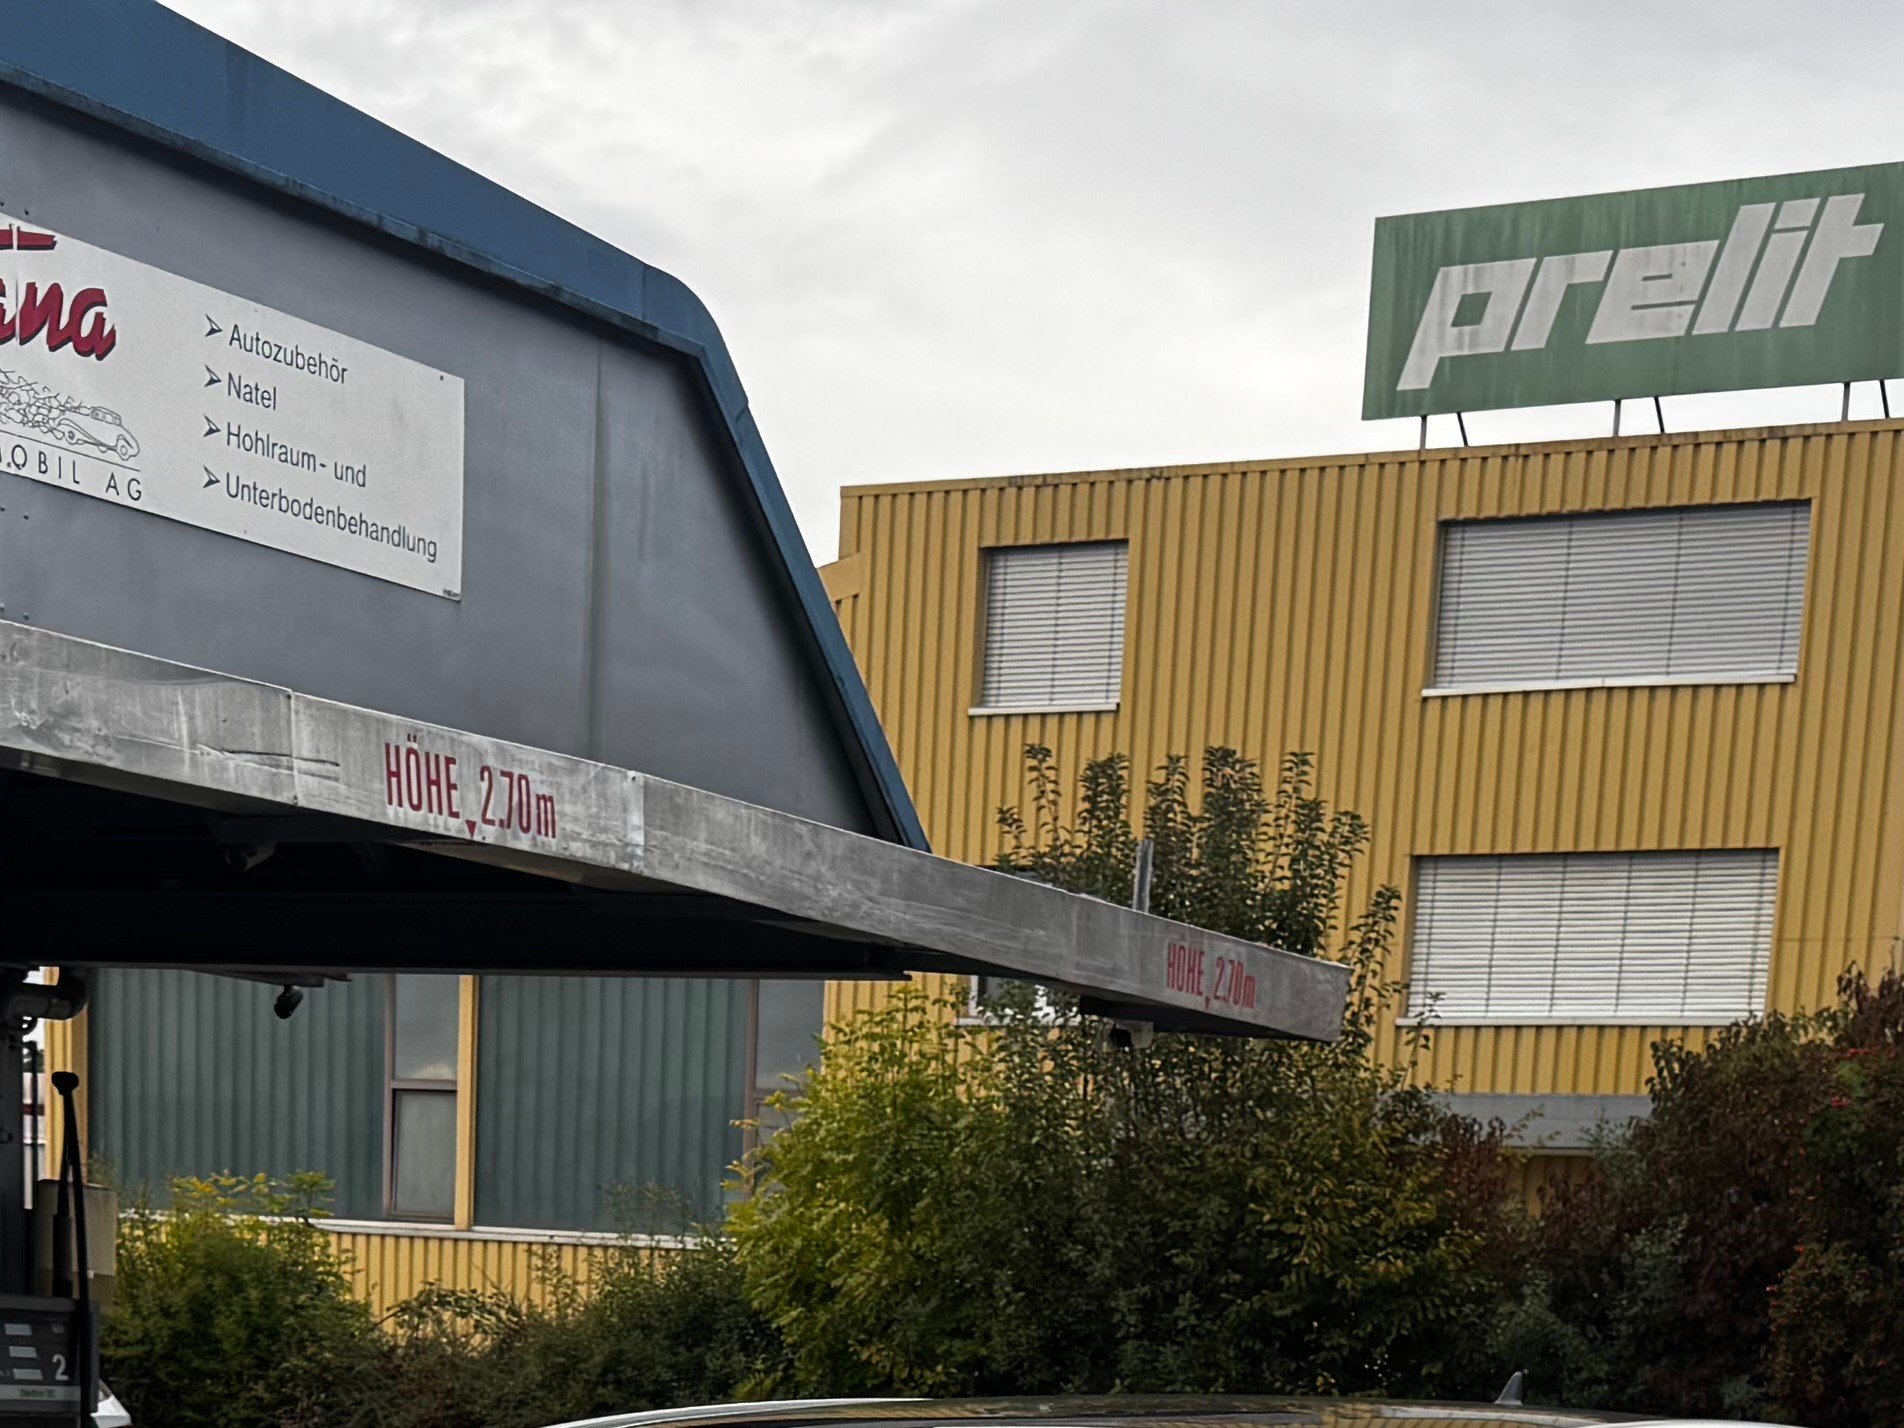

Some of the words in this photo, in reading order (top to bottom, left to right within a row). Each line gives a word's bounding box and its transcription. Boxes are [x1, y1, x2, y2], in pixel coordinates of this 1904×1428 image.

[1396, 193, 1885, 391] prelit
[228, 323, 348, 385] Autozubehör
[227, 371, 277, 411] Natel
[105, 472, 142, 501] AG
[226, 421, 327, 473] Hohlraum-
[333, 461, 367, 488] und
[225, 471, 437, 563] Unterbodenbehandlung
[385, 733, 460, 819] HÖHE
[52, 1353, 70, 1382] 2
